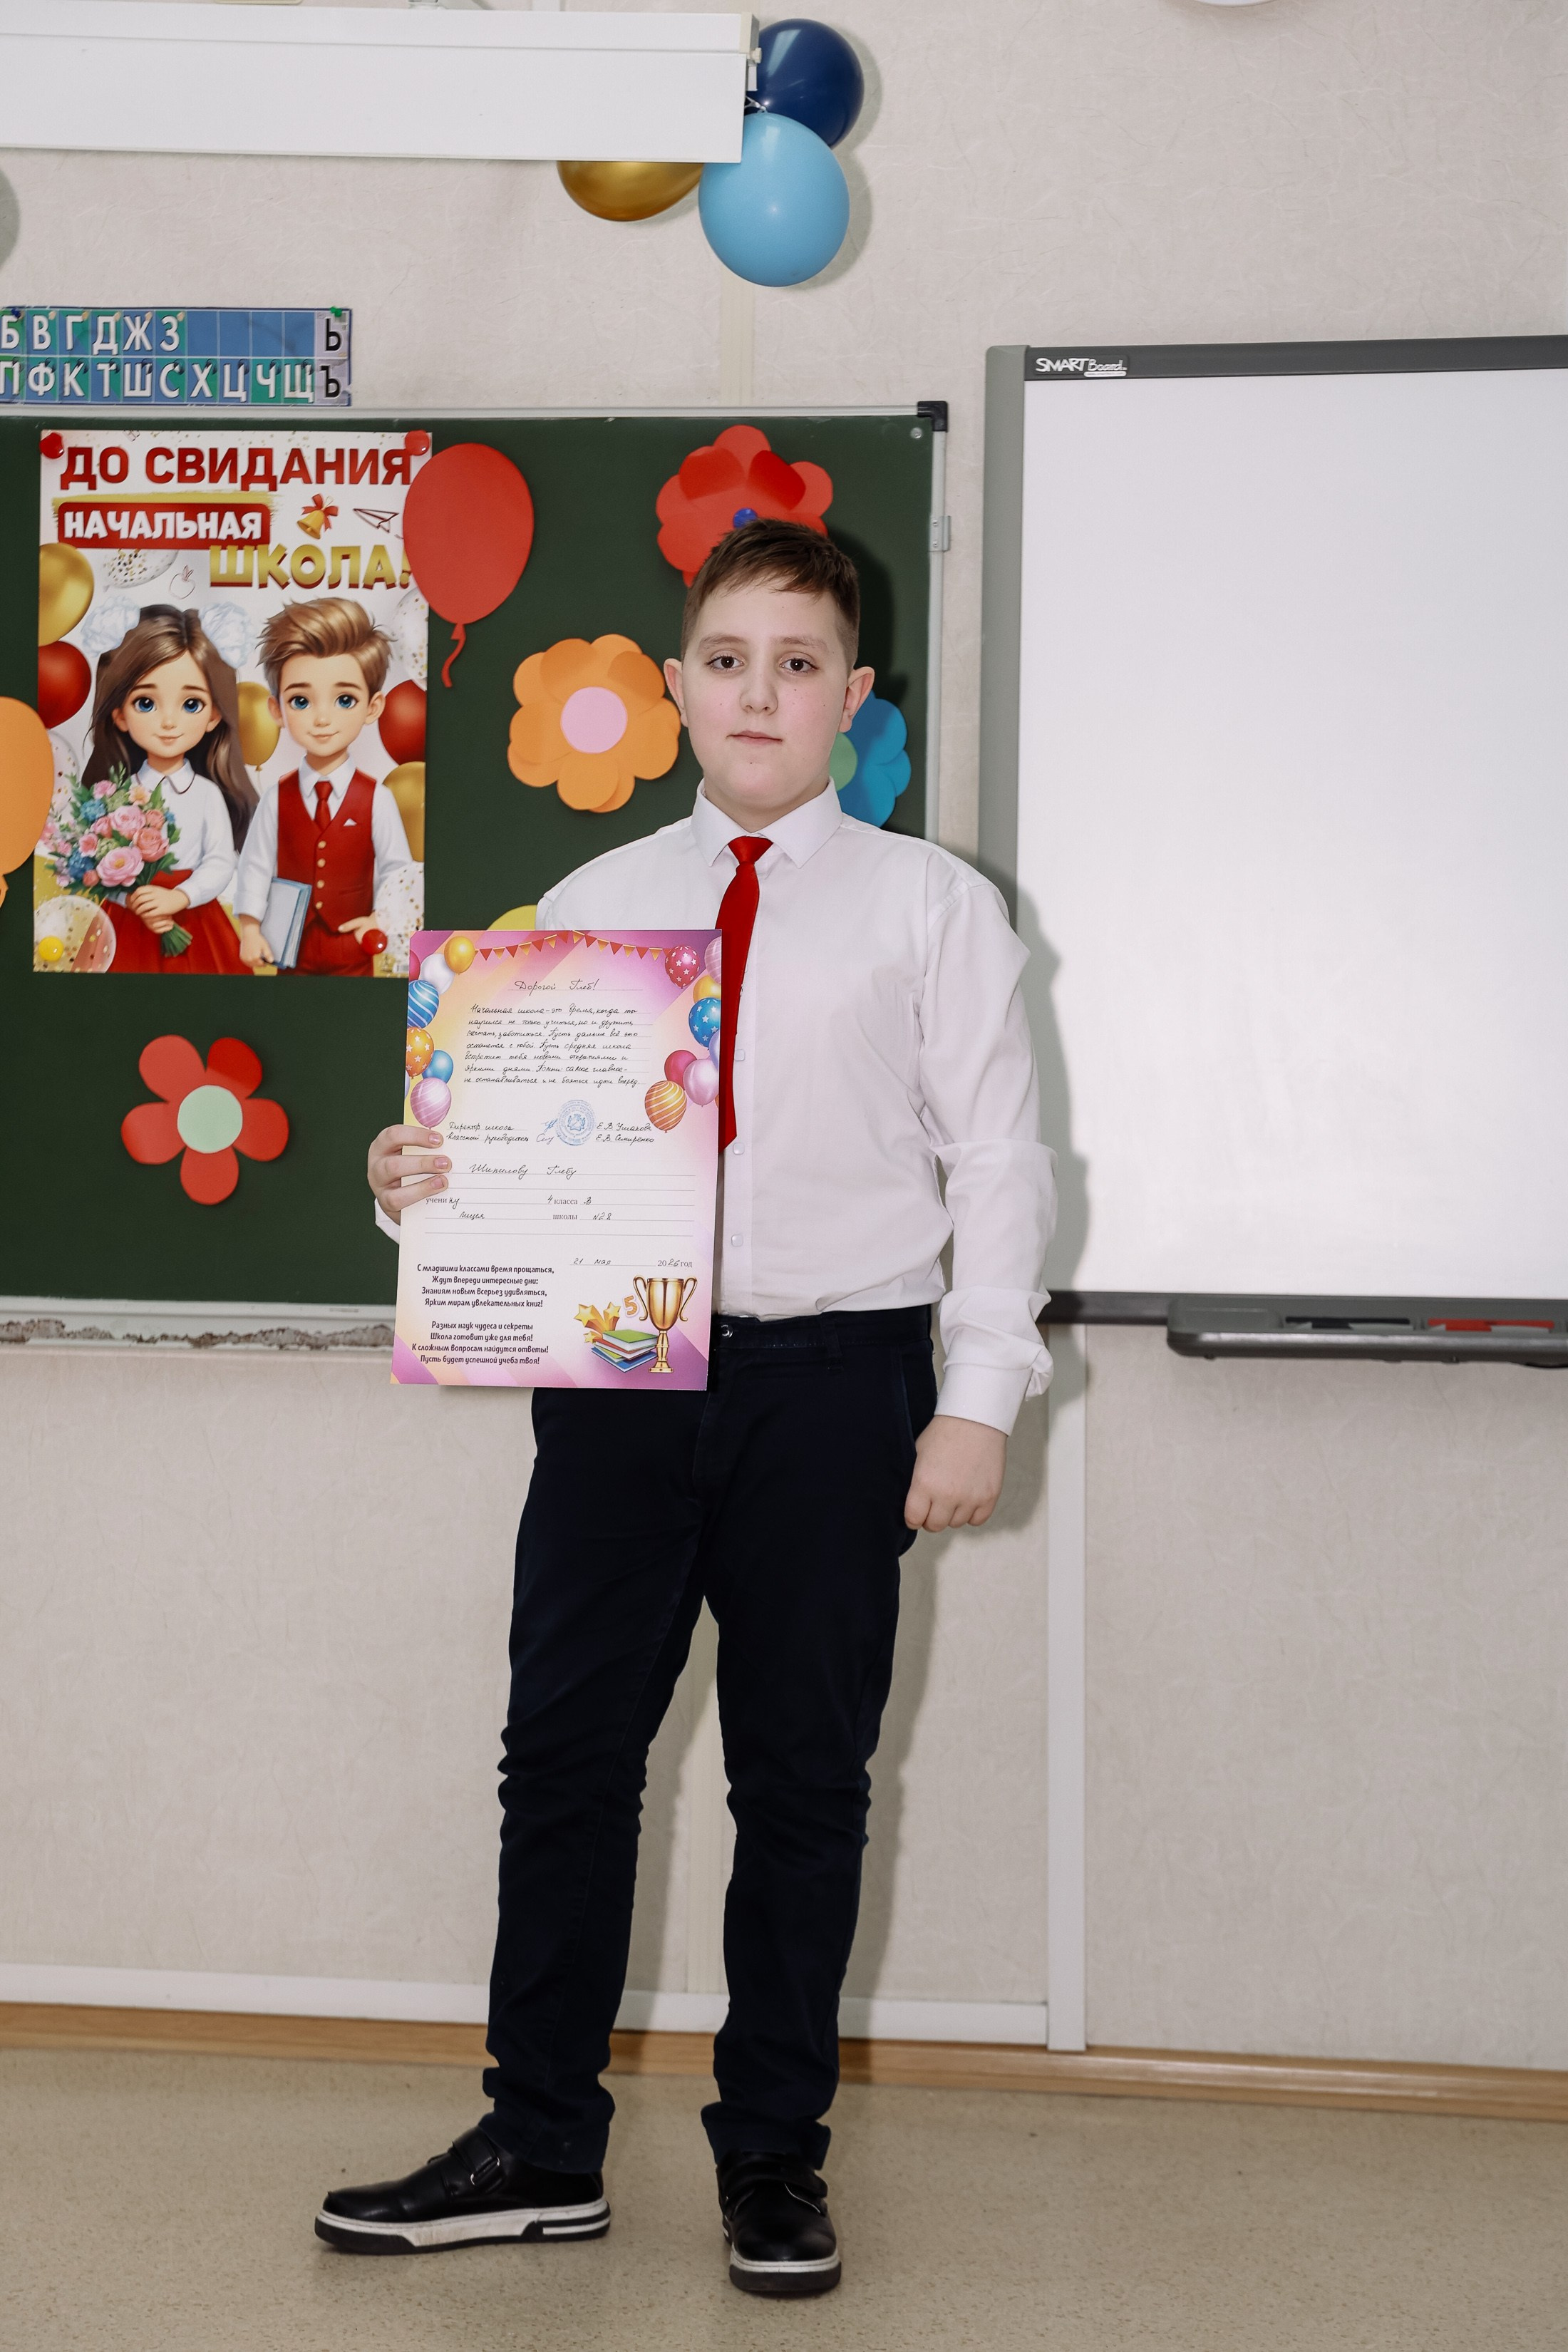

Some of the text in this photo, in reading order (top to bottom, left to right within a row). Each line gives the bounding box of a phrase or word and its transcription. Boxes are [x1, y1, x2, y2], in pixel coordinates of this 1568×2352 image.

[1, 314, 20, 349] Б
[33, 314, 51, 350] В
[66, 314, 84, 350] Г
[92, 315, 118, 356] Д
[123, 315, 153, 351] Ж
[28, 362, 55, 396] Ф
[63, 362, 85, 396] К
[96, 363, 117, 397] Т
[123, 363, 152, 397] Ш
[159, 363, 180, 398] С
[190, 363, 213, 398] Х
[223, 363, 247, 403] Ц
[256, 363, 276, 398] Ч
[284, 363, 314, 403] Щ
[60, 446, 411, 492] ДО СВИДАНИЯ
[63, 510, 262, 540] НАЧАЛЬНАЯ
[514, 979, 600, 996] Дорогой Глеб!
[470, 1004, 512, 1013] Начальная
[468, 1020, 502, 1029] научился
[548, 1027, 571, 1041] Пусть
[574, 1031, 605, 1041] дальше
[540, 1038, 559, 1052] Пусть
[564, 1042, 597, 1053] средняя
[533, 1051, 561, 1060] новыми
[465, 1063, 495, 1073] яркими
[593, 1079, 613, 1088] идти
[449, 1121, 480, 1132] Директор
[547, 1165, 577, 1180] Глебу
[490, 1265, 512, 1274] время
[432, 1276, 453, 1284] Ждут
[453, 1276, 481, 1284] впереди
[477, 1287, 503, 1296] всерьез
[504, 1288, 547, 1297] удивляться,
[425, 1298, 447, 1306] Ярким
[471, 1299, 525, 1308] увлекательных
[624, 1295, 638, 1316] 5
[431, 1321, 457, 1330] Разных
[503, 1323, 533, 1331] секреты
[450, 1344, 483, 1353] вопросам
[484, 1345, 517, 1353] найдутся
[420, 1355, 441, 1364] Пусть
[443, 1355, 464, 1364] будет
[465, 1356, 497, 1365] успешной
[498, 1356, 518, 1365] учеба
